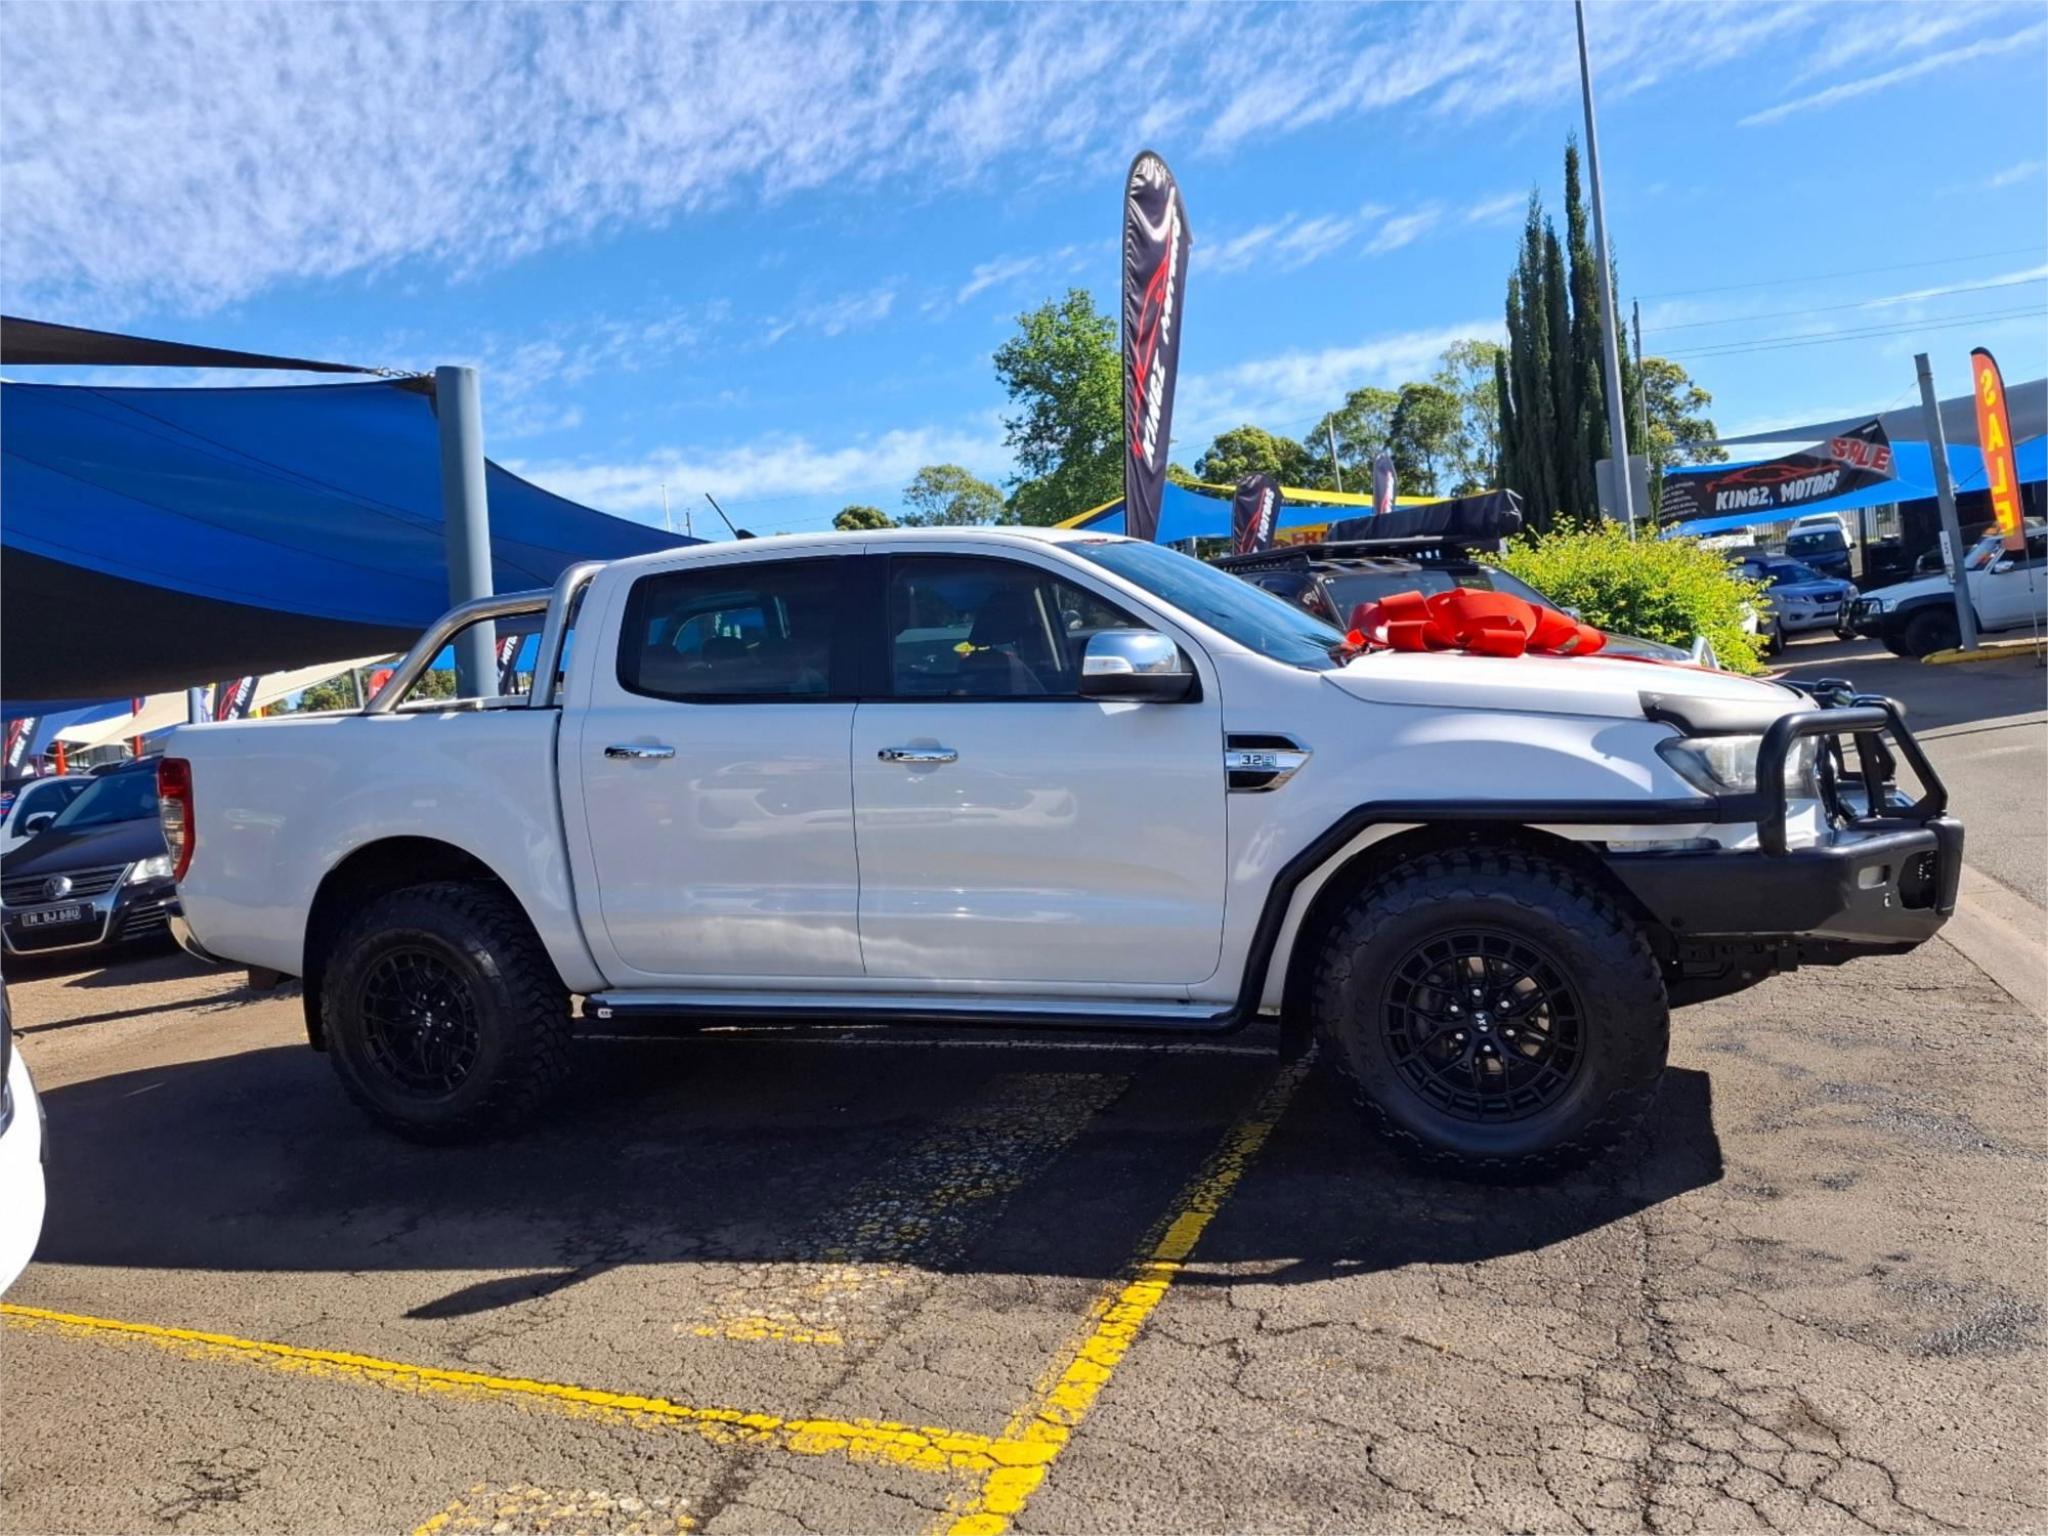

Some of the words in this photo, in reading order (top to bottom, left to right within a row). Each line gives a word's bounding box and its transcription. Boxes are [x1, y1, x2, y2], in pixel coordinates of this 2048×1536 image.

[1143, 347, 1166, 470] KINGZ
[1831, 437, 1891, 472] SALE
[1780, 470, 1840, 502] MOTORS
